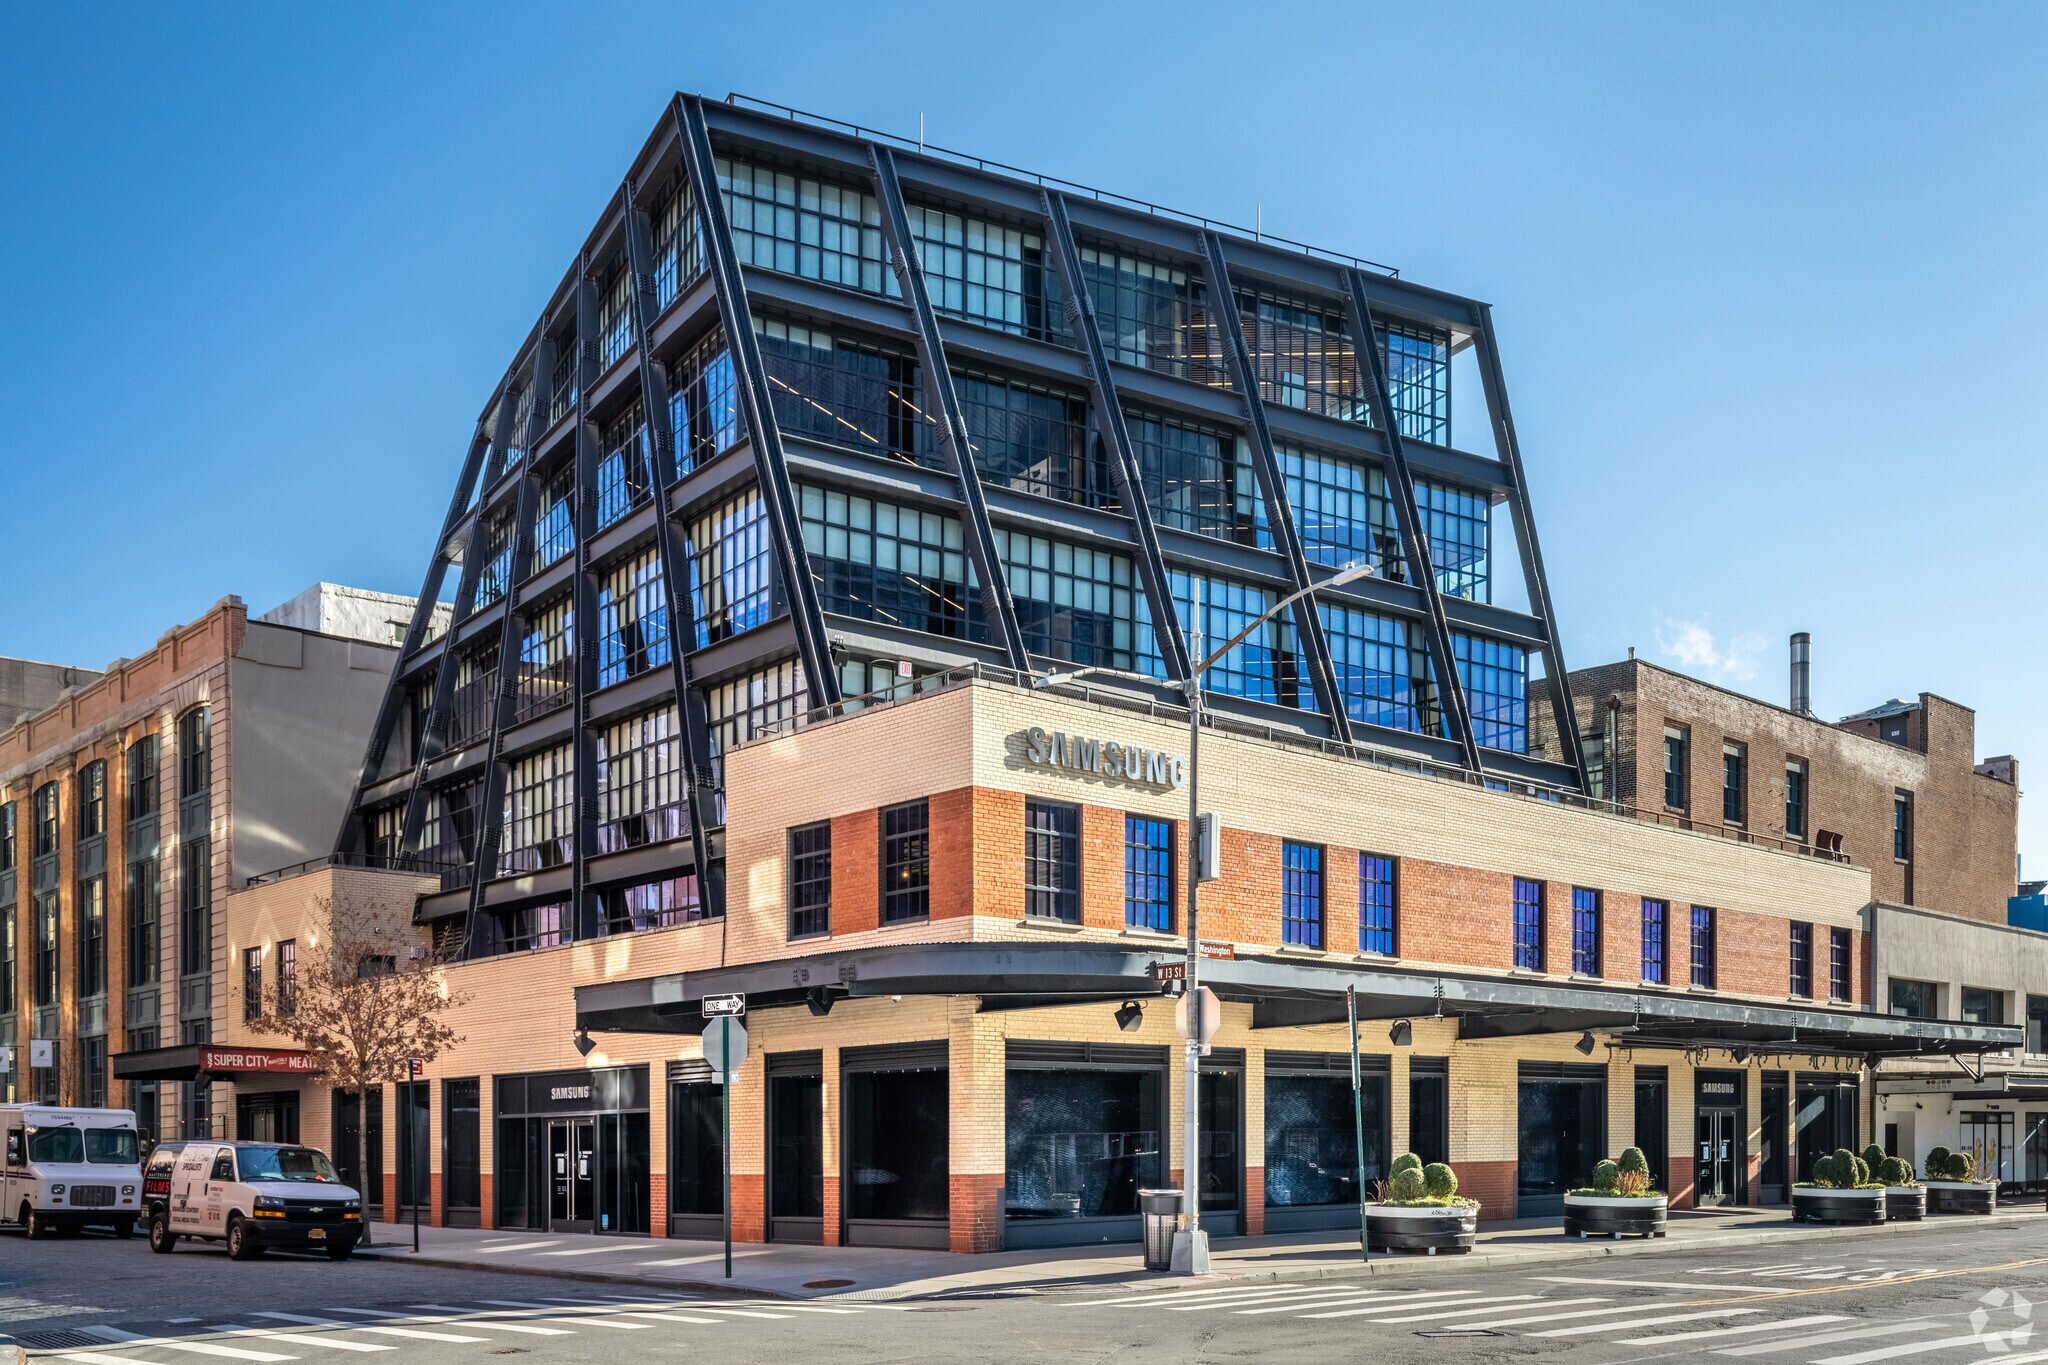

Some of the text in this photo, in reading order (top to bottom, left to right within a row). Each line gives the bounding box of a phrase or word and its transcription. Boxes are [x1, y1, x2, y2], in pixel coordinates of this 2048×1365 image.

[1028, 726, 1187, 789] SAMSUNG
[1200, 944, 1231, 957] Washington
[1157, 967, 1182, 979] W 13 St
[706, 1000, 740, 1011] ONE WAY
[213, 1054, 243, 1067] SUPER
[245, 1055, 270, 1068] CITY
[551, 1085, 589, 1100] SAMSUNG
[1703, 1082, 1735, 1094] SAMSUNG
[146, 1181, 170, 1193] FILMS
